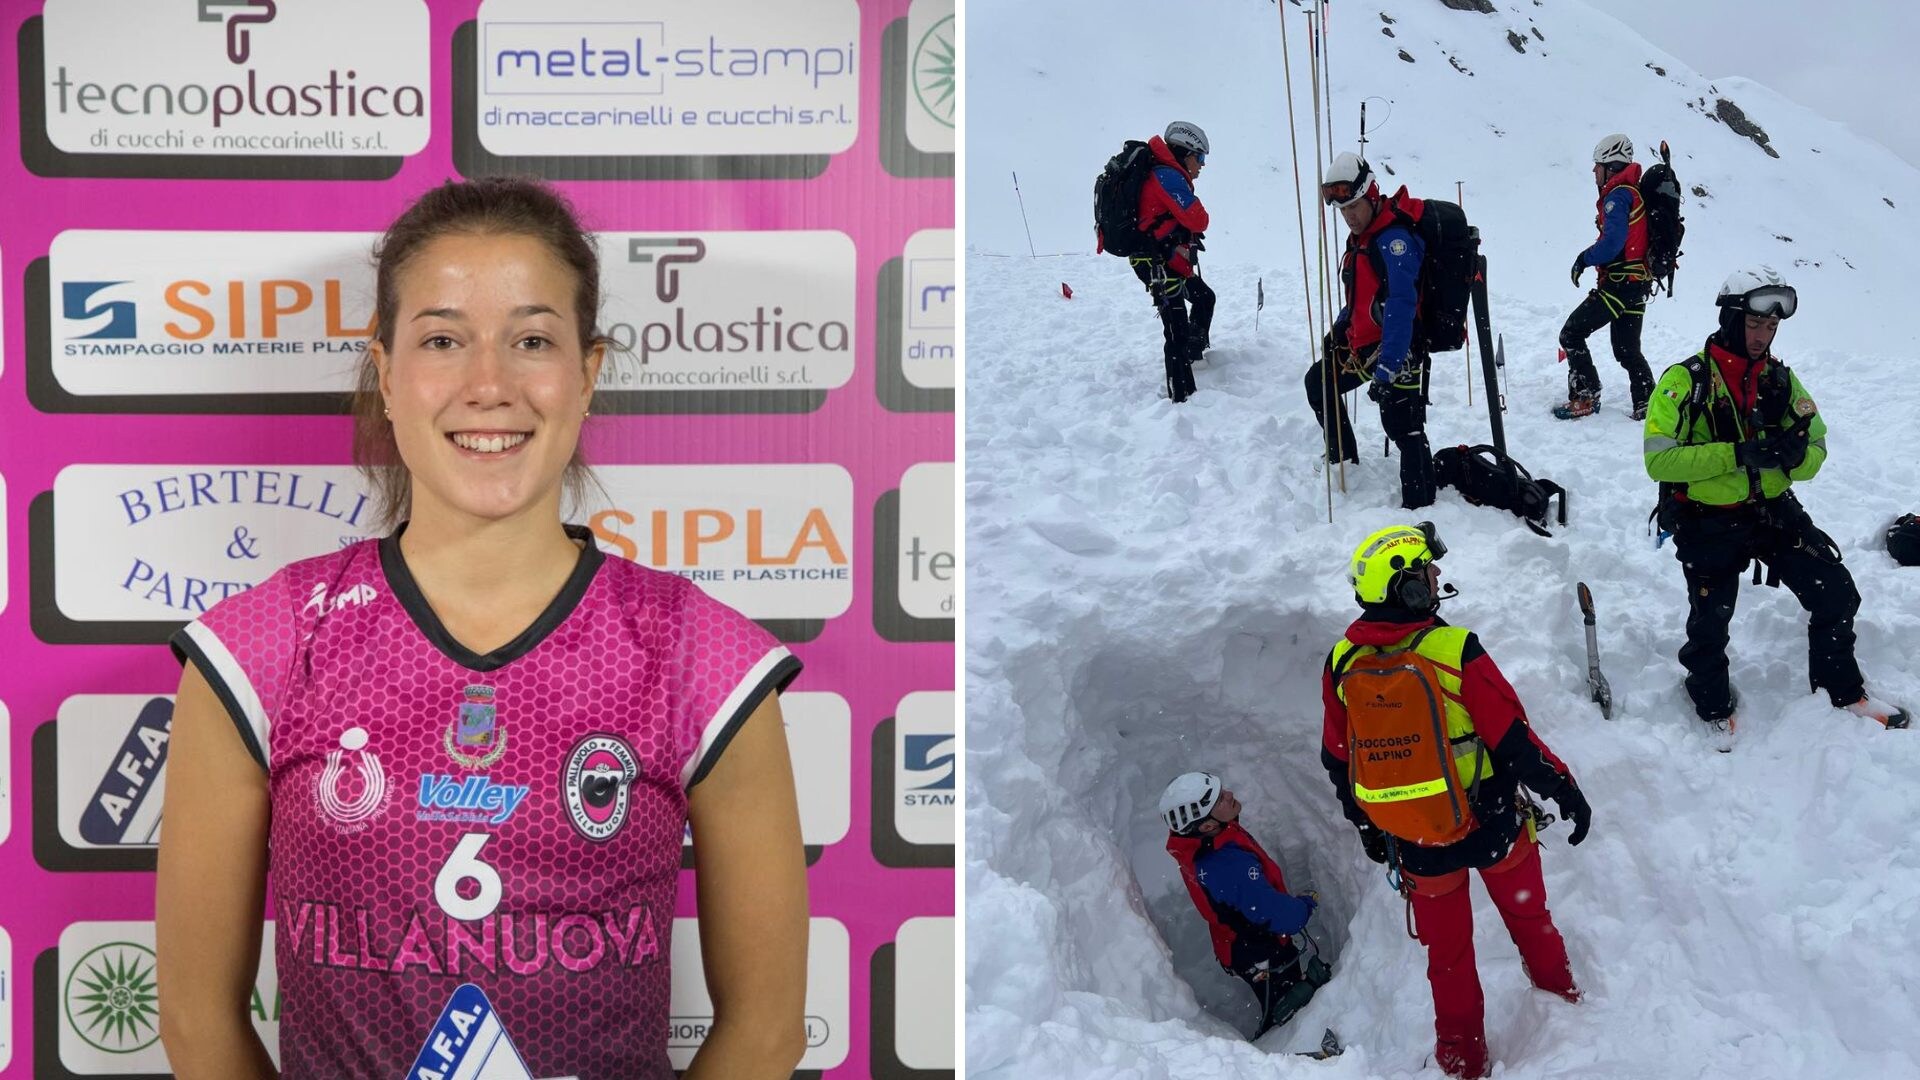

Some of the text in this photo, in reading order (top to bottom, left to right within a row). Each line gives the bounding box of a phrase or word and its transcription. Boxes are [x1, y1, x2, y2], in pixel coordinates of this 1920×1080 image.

[496, 36, 854, 89] metal-stampi
[52, 66, 424, 128] tecnoplastica
[484, 105, 852, 126] di maccarinelli e cucchi s.r.l.
[90, 129, 388, 151] di cucchi e maccarinelli s.r.l.
[64, 341, 367, 356] STAMPAGGIO MATERIE PLAS
[606, 306, 849, 365] oplastica
[641, 365, 769, 385] maccarinelli
[777, 366, 813, 385] s.r.l.
[116, 470, 371, 527] BERTELLI
[226, 525, 261, 560] &
[588, 508, 848, 567] SIPLA
[121, 557, 255, 613] PART
[668, 568, 849, 582] ERIE PLASTICHE
[568, 741, 598, 788] PALLAVOLO
[1357, 733, 1421, 750] SOCCORSO
[1367, 748, 1413, 762] ALPINO
[418, 773, 530, 825] Volley
[572, 802, 625, 835] VILLANUOVA
[434, 833, 503, 921] 6
[281, 901, 661, 977] VILLANUOVA
